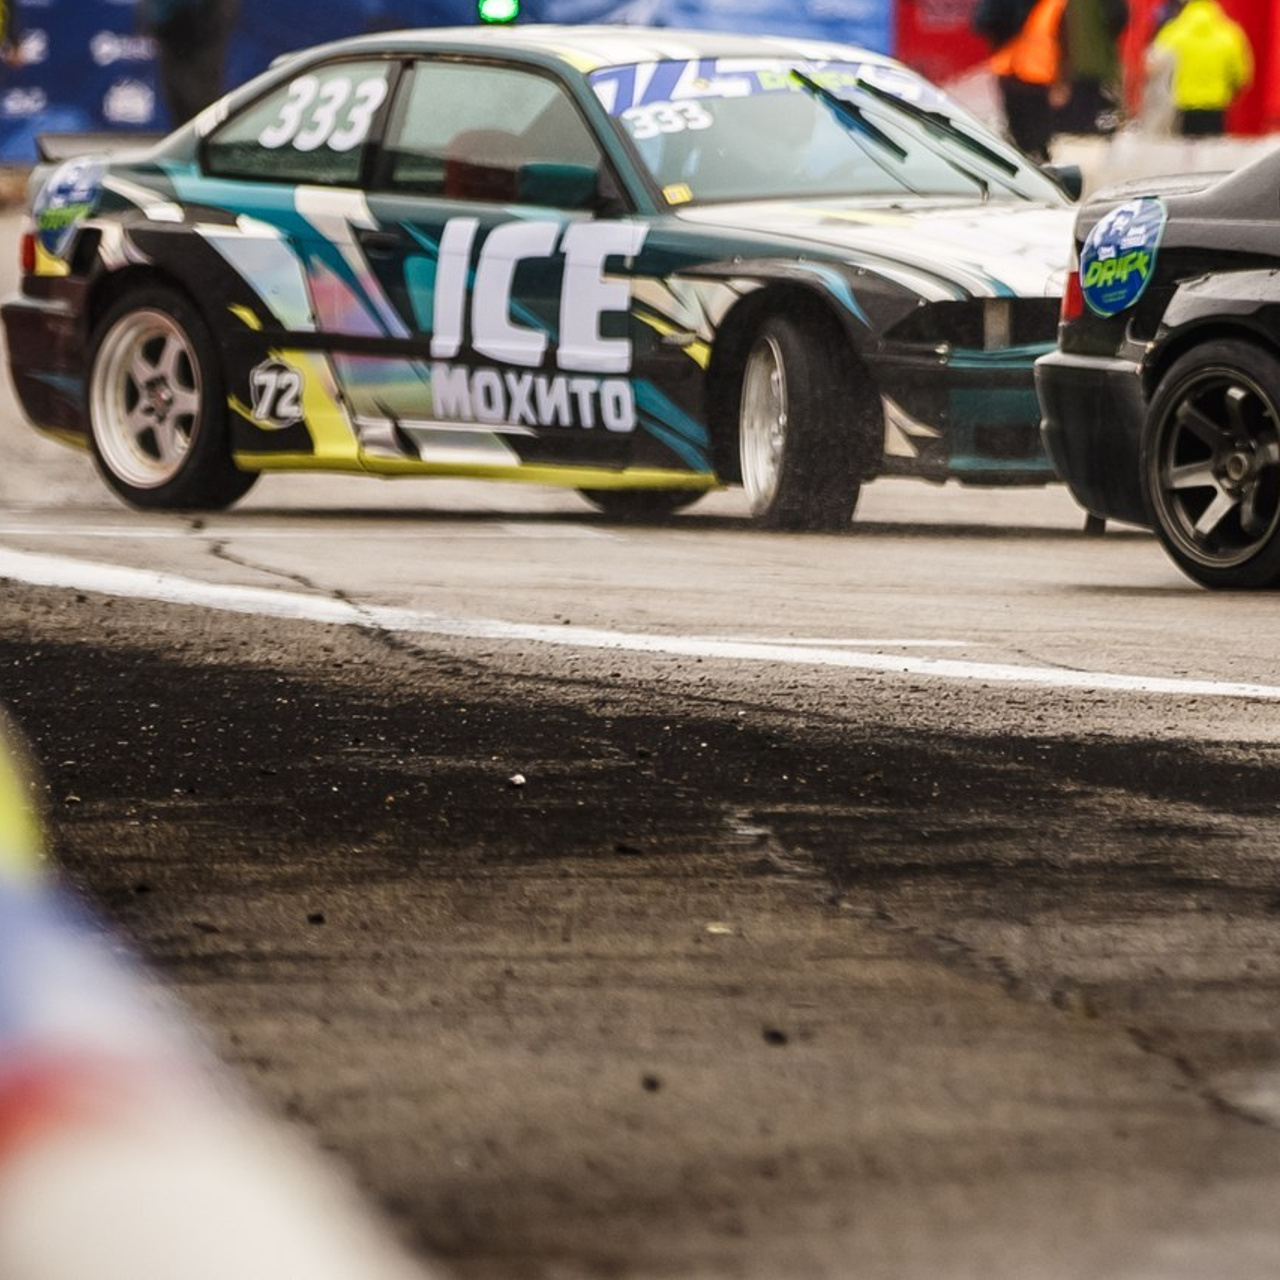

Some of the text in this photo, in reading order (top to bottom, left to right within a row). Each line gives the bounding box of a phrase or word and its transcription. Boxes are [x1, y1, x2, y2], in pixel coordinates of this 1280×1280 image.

[259, 74, 388, 151] 333
[622, 99, 713, 139] 333
[431, 217, 650, 373] ICE
[253, 372, 301, 420] 72
[431, 362, 636, 432] МОХИТО
